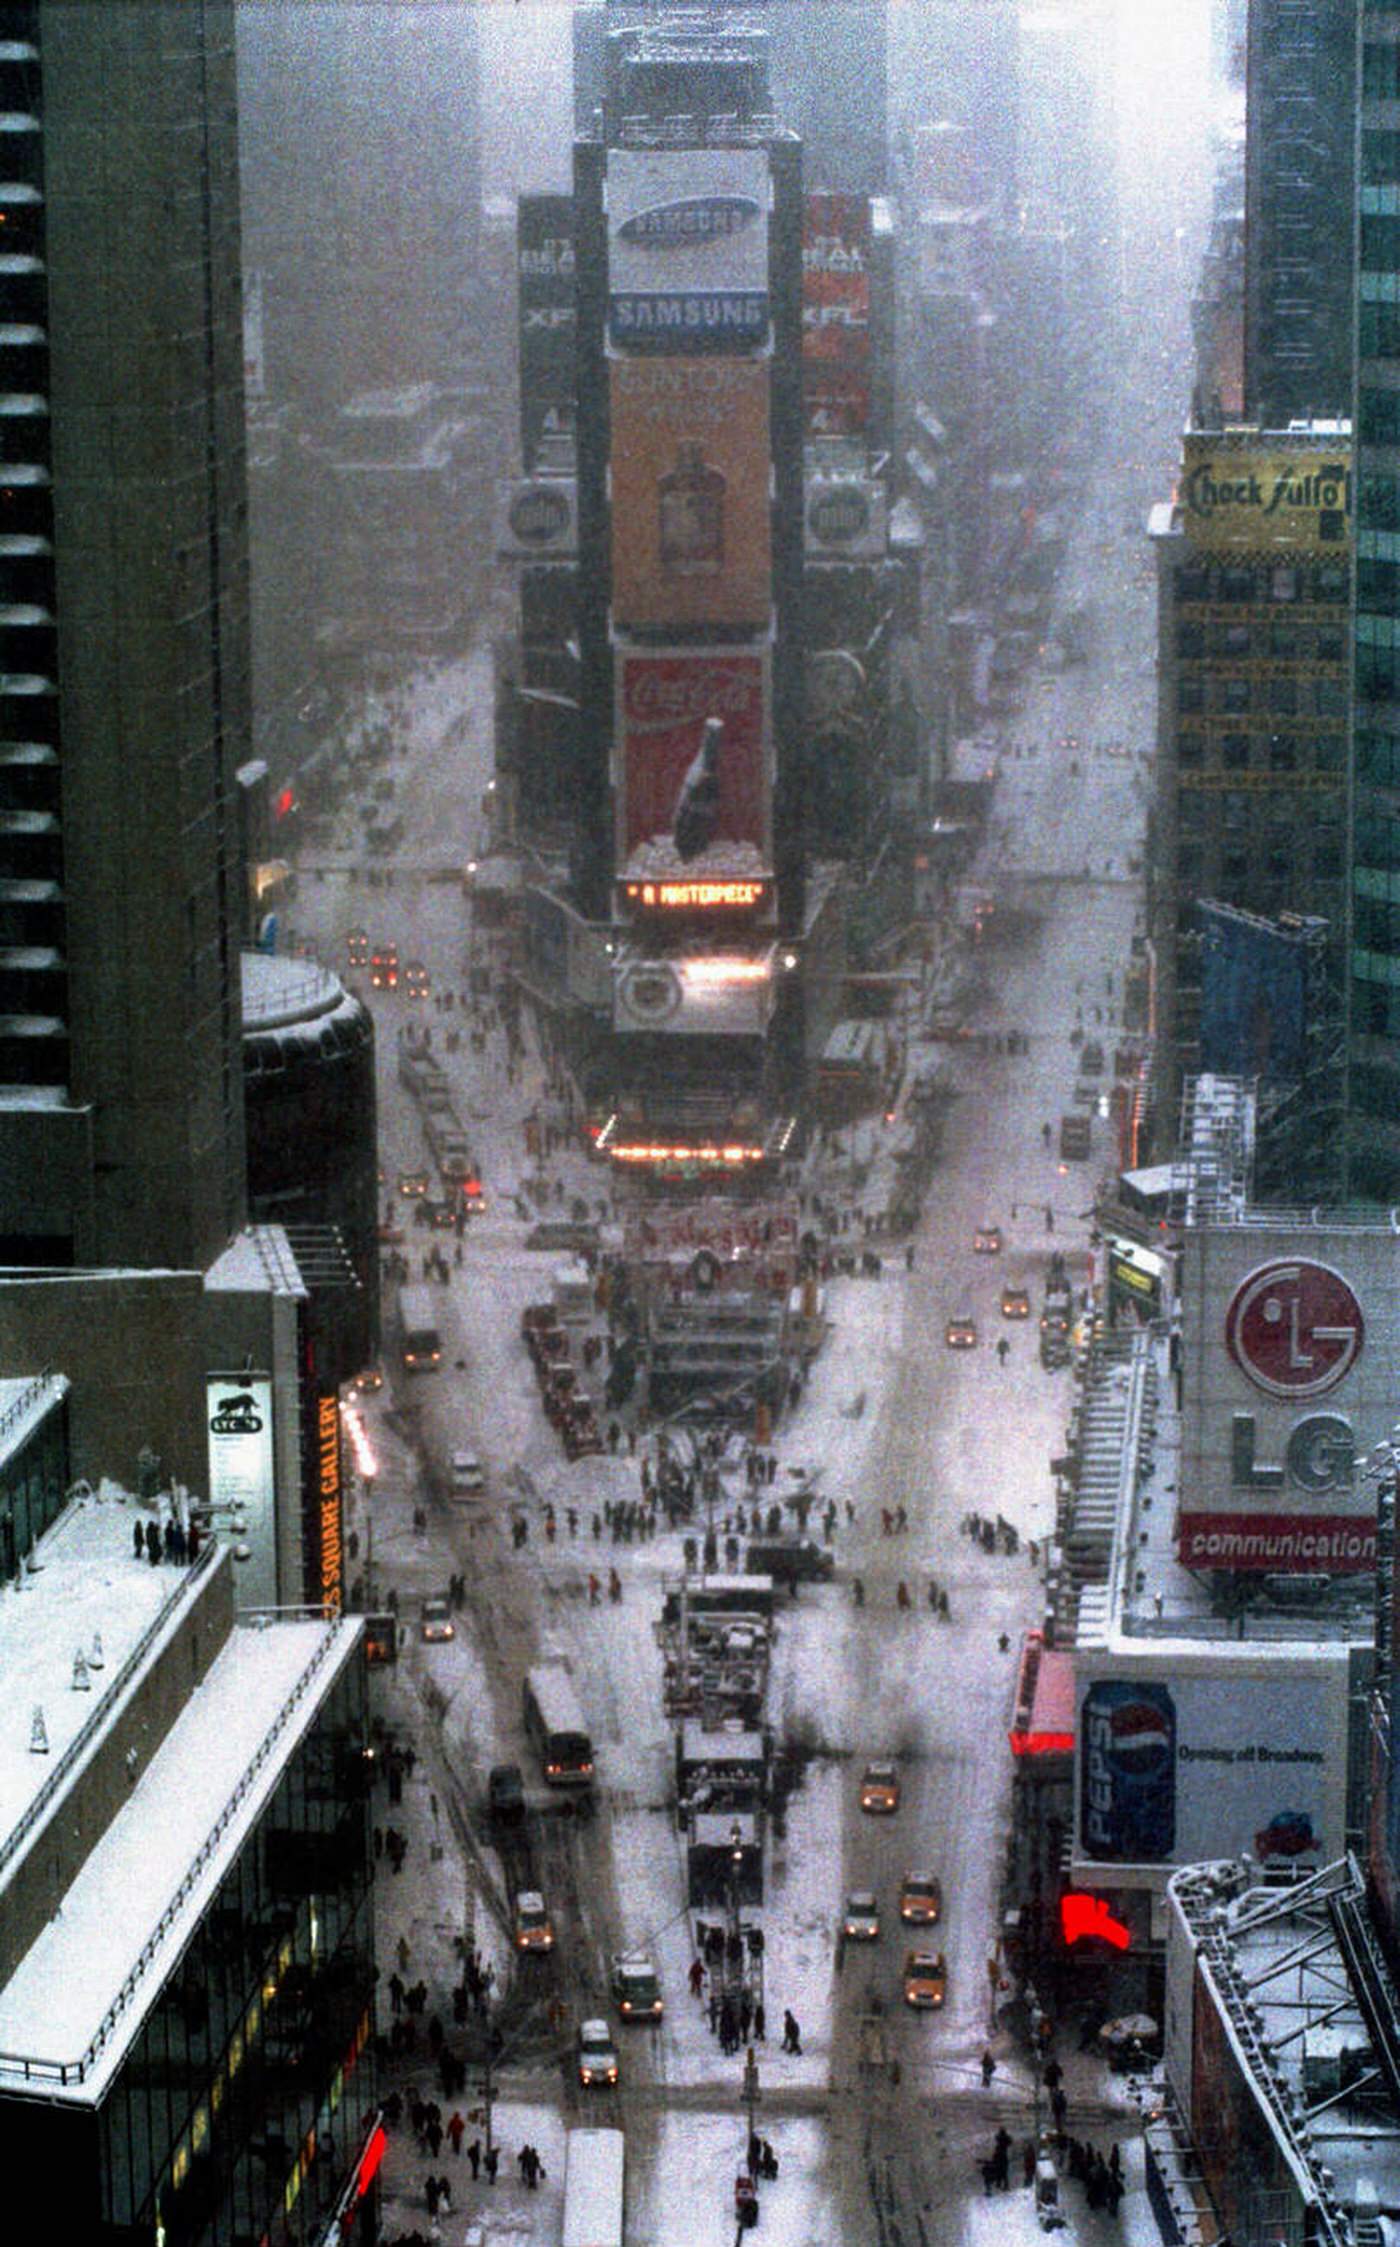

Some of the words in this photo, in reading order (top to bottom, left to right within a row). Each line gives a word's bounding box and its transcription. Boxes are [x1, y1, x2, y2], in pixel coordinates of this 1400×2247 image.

[616, 300, 761, 327] SAMSUNG
[1187, 464, 1262, 518] Chock
[318, 1396, 340, 1494] GALLERY
[1231, 1412, 1357, 1492] LG
[320, 1497, 342, 1587] SQUARE
[1191, 1532, 1377, 1559] communication
